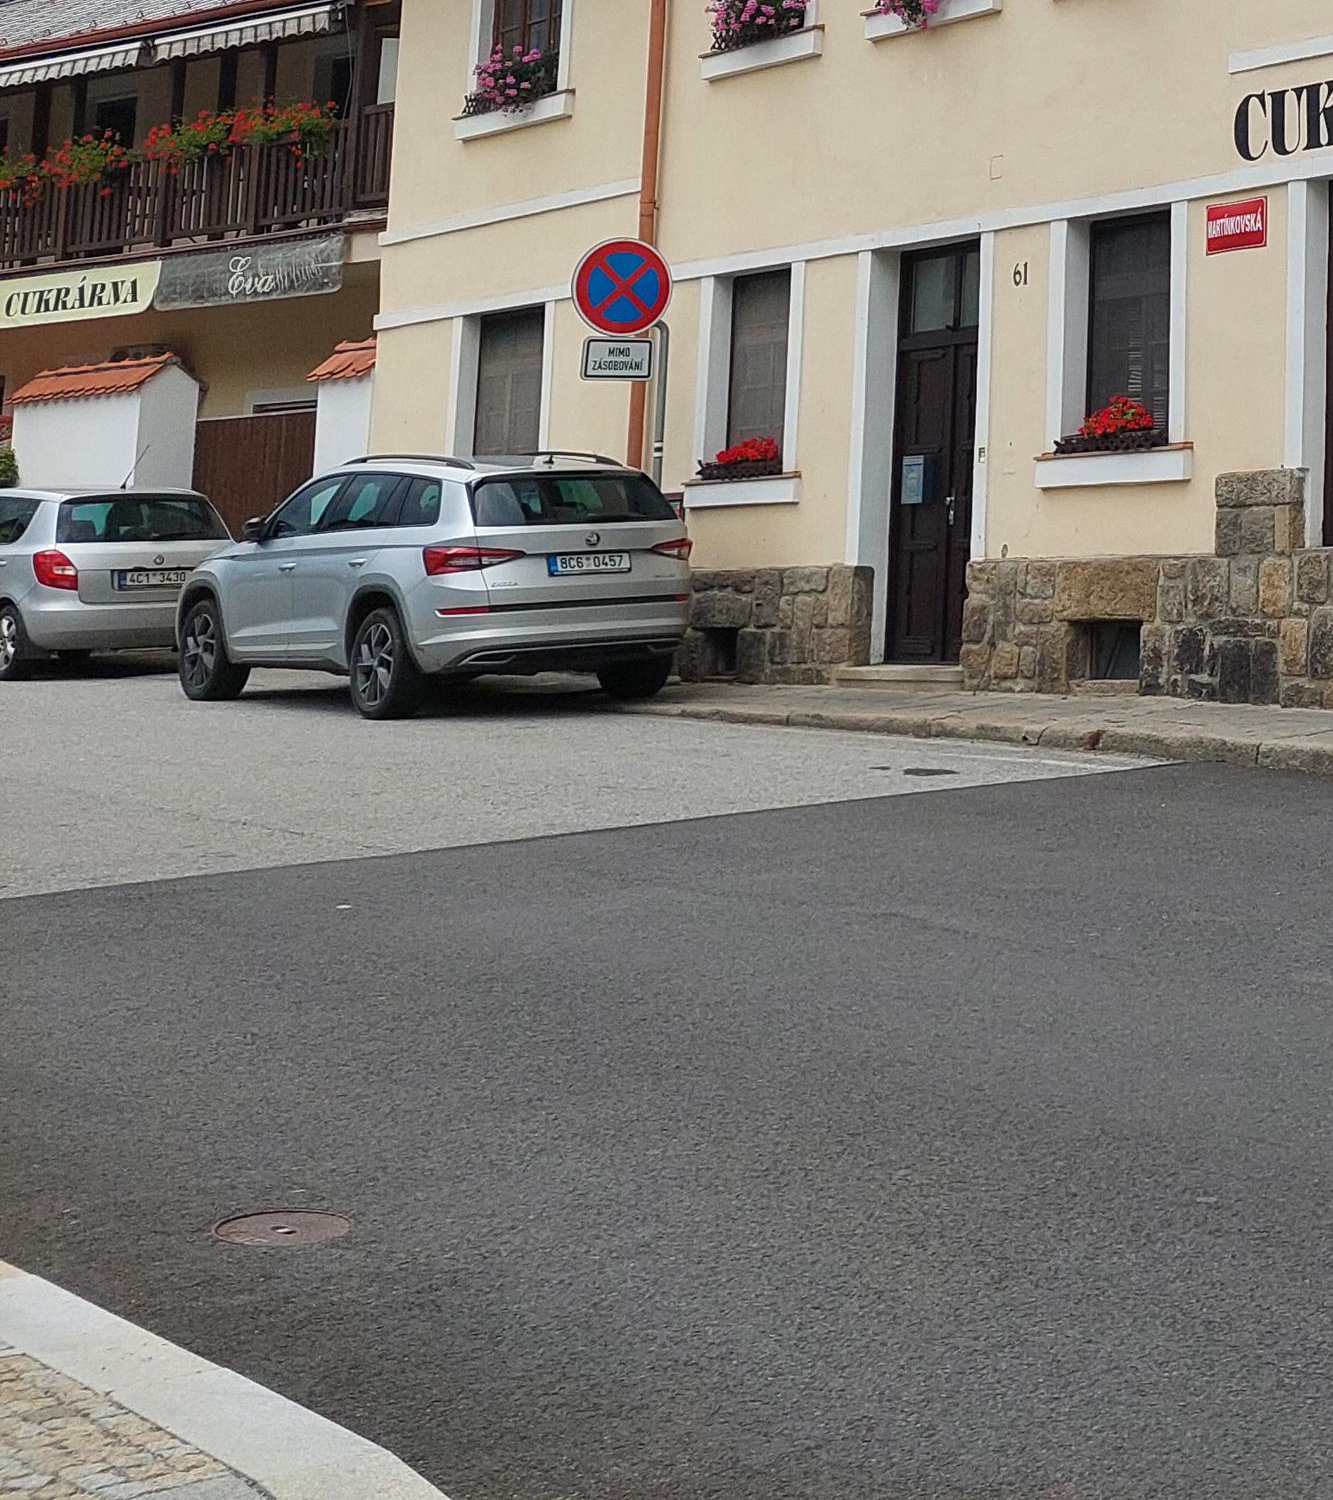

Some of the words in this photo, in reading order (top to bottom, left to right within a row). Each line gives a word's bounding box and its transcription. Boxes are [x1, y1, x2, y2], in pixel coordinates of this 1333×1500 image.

[1208, 206, 1262, 238] MARTÍNKOVSKÁ
[228, 257, 275, 297] Eva
[1013, 261, 1028, 286] 61
[5, 276, 138, 317] CUKRÁRNA
[608, 347, 631, 357] MIMO
[592, 358, 644, 371] ZÁSOBOVÁNÍ
[560, 556, 584, 569] 8C6
[594, 555, 624, 568] 0457
[129, 573, 150, 583] 4C1
[159, 571, 186, 583] 3430
